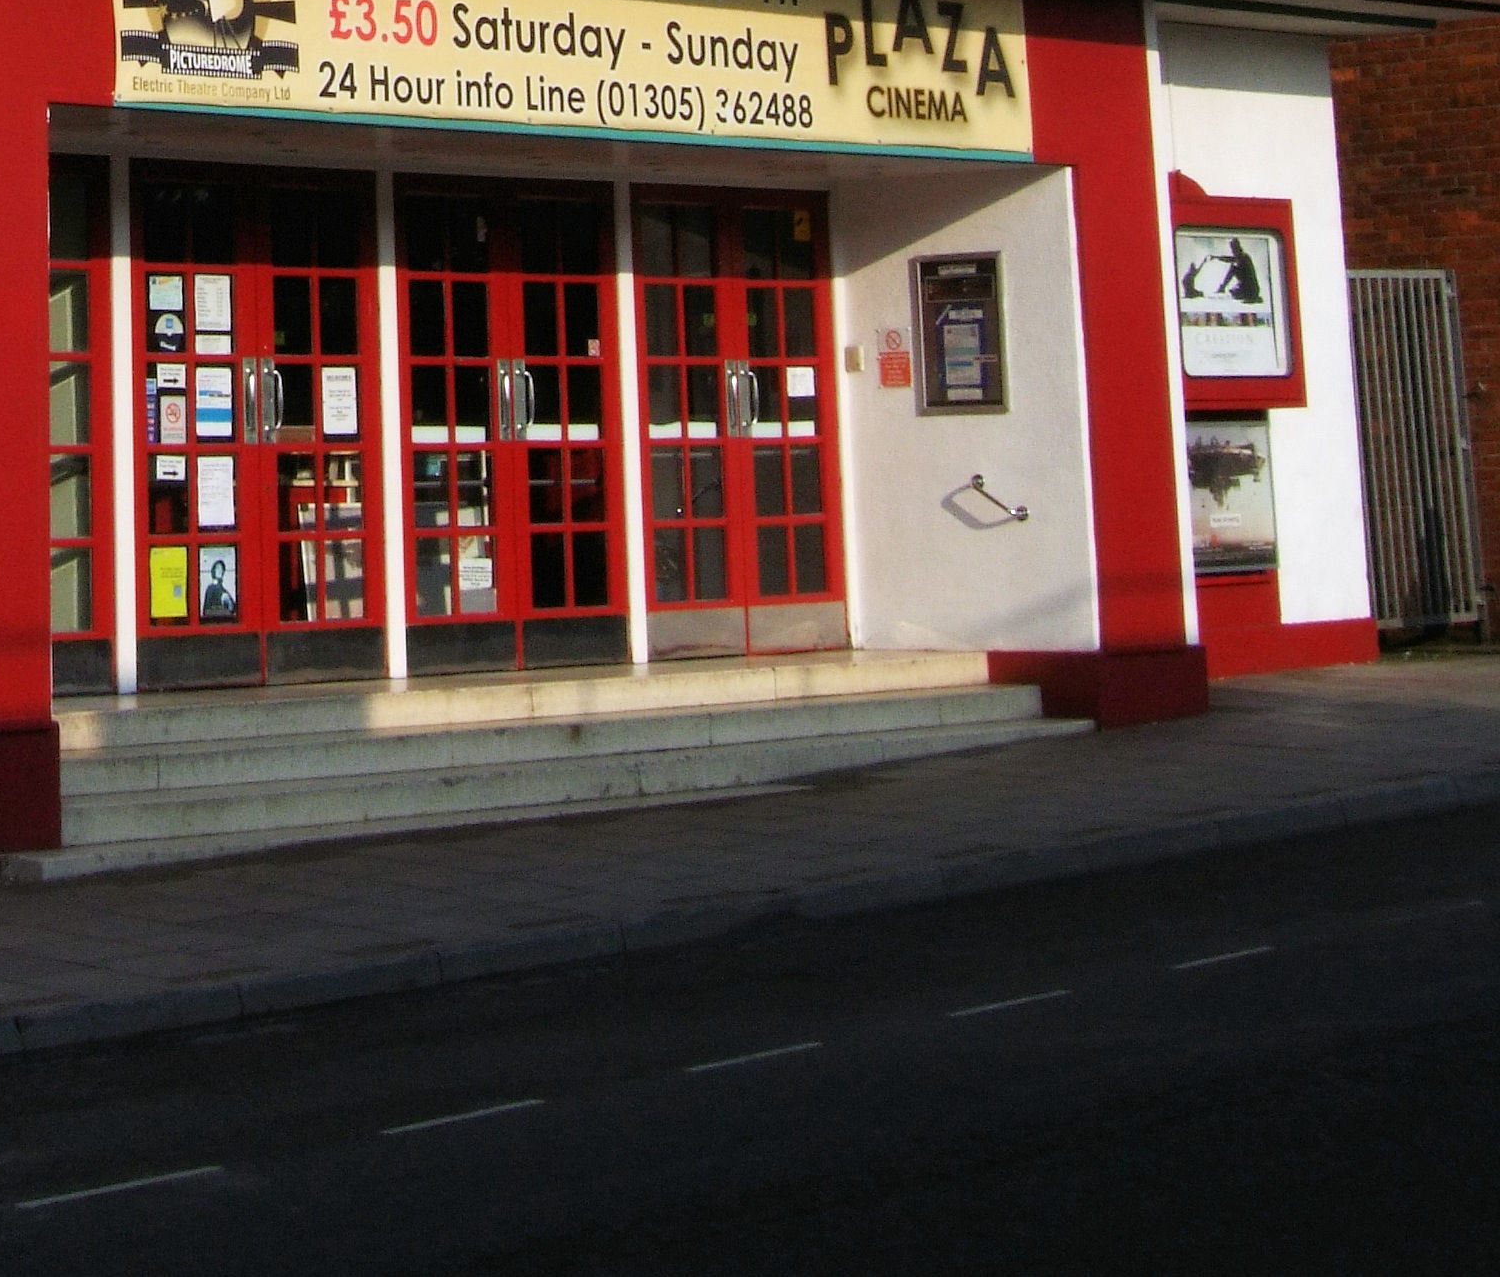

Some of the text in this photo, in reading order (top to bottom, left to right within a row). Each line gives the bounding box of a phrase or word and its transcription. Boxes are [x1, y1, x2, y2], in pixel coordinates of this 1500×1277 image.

[169, 49, 252, 74] PICTUREDROME
[453, 3, 626, 70] Saturday
[667, 21, 799, 83] Sunday
[132, 76, 291, 102] Electric Theatre Company Ltd
[318, 61, 358, 100] 24
[370, 64, 446, 105] Hour
[455, 69, 514, 110] info
[526, 76, 586, 116] Line
[597, 80, 706, 131] (01305)
[866, 86, 968, 123] CINEMA
